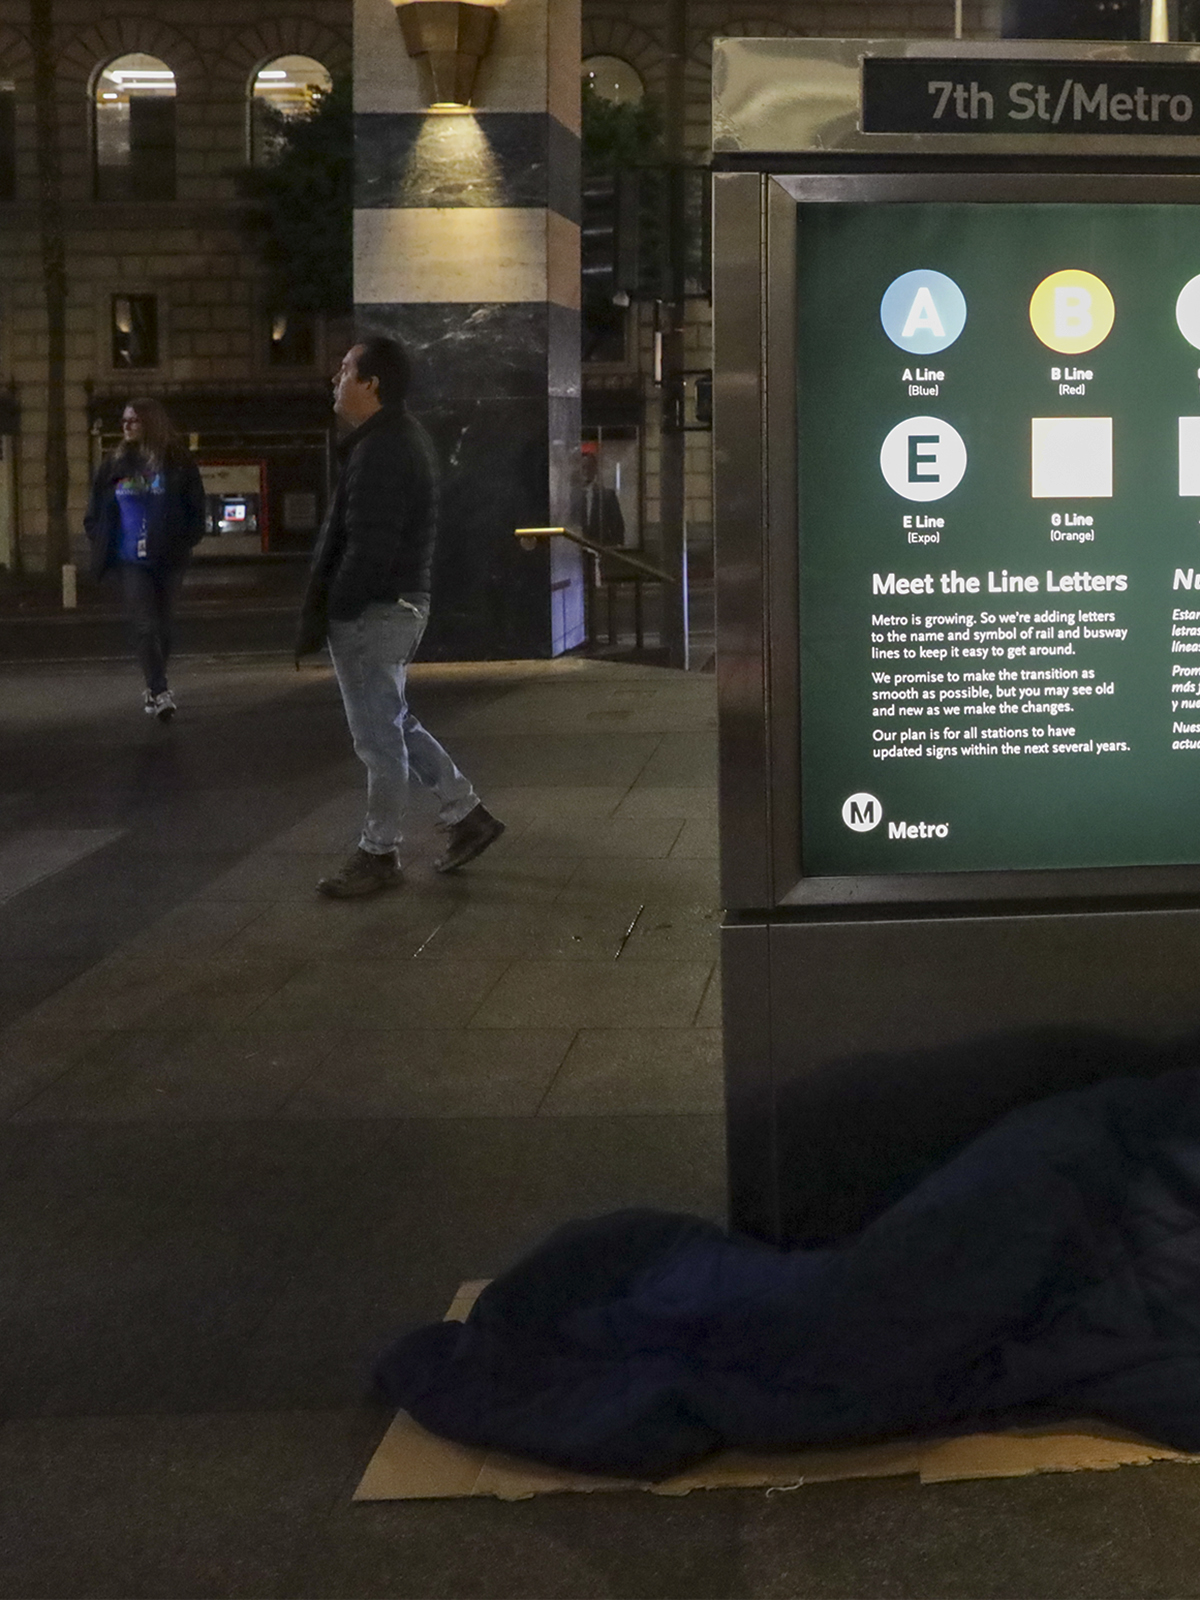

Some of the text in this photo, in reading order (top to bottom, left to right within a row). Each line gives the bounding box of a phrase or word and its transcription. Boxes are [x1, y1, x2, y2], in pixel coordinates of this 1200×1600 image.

[927, 80, 993, 120] 7th
[1008, 79, 1194, 125] St/Metro
[901, 286, 946, 338] A
[1053, 285, 1095, 339] B
[902, 368, 945, 381] A Line
[1051, 367, 1093, 380] B Line
[908, 384, 939, 396] (Blue)
[1059, 383, 1085, 395] (Red)
[907, 435, 940, 483] E
[903, 515, 945, 528] E Line
[1051, 513, 1094, 526] G Line
[908, 531, 940, 545] (Expo)
[1050, 529, 1094, 543] (Orange)
[873, 569, 1128, 595] Meet the Line Letters
[872, 614, 908, 626] Metro
[912, 614, 922, 625] is
[925, 613, 977, 628] growing.
[980, 612, 996, 624] So
[1034, 610, 1075, 626] adding
[1078, 610, 1115, 622] letters
[871, 626, 1128, 643] to the name and symbol of rail and busway
[872, 642, 1076, 661] lines to keep it easy to get around.
[871, 668, 1095, 686] We promise to make the transition as
[872, 682, 1114, 702] smooth as possible, but you may see old
[1171, 681, 1196, 693] más
[872, 700, 1074, 716] and new as we make the changes.
[1171, 700, 1179, 712] y
[872, 724, 1076, 744] Our plan is for all stations to have
[873, 739, 1130, 760] updated signs within the next several years.
[850, 801, 874, 824] M
[888, 821, 948, 839] Metro
